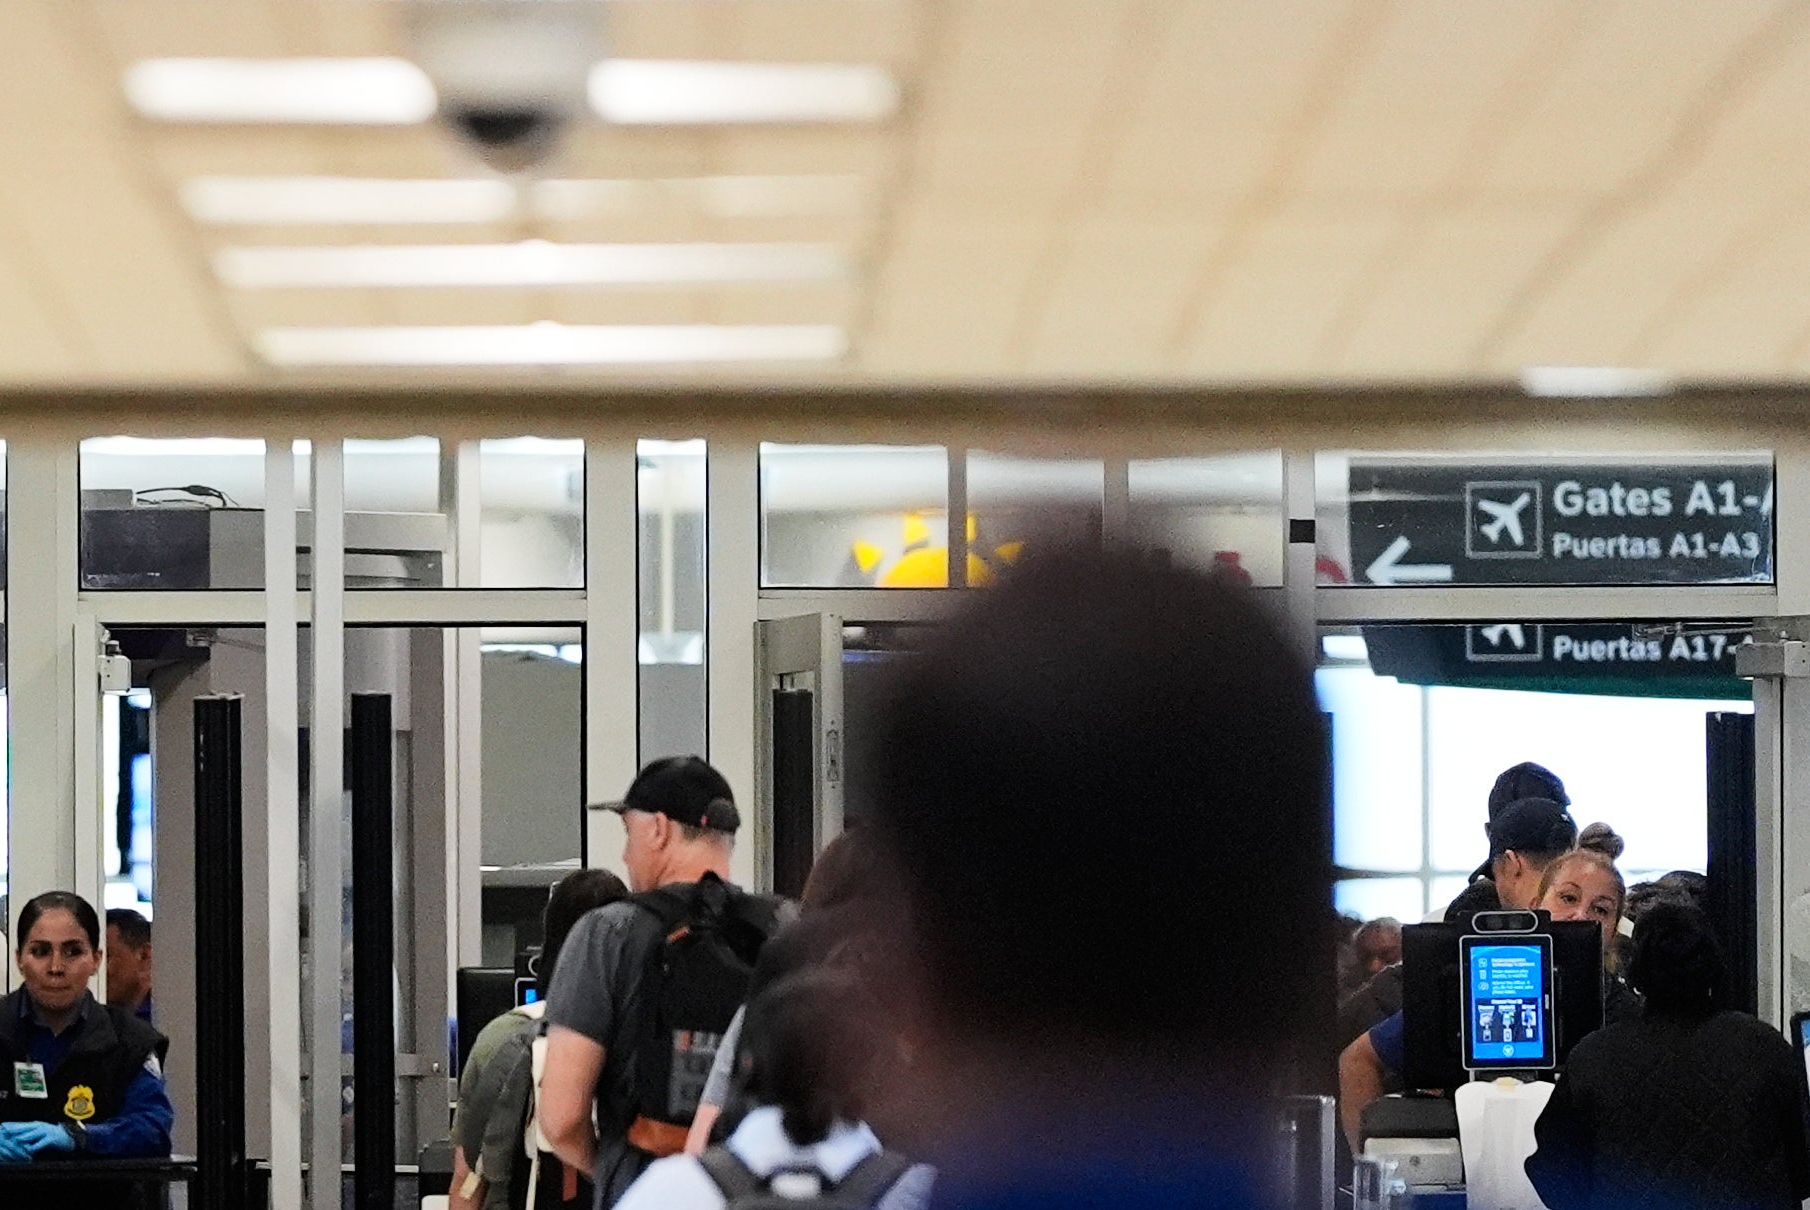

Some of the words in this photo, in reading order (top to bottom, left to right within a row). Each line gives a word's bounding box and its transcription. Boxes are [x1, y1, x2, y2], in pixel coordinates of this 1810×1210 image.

[1553, 480, 1673, 517] Gates
[1553, 531, 1663, 560] Puertas
[1668, 531, 1761, 560] A1-A3
[1553, 635, 1662, 662] Puertas
[1668, 633, 1754, 662] A17-
